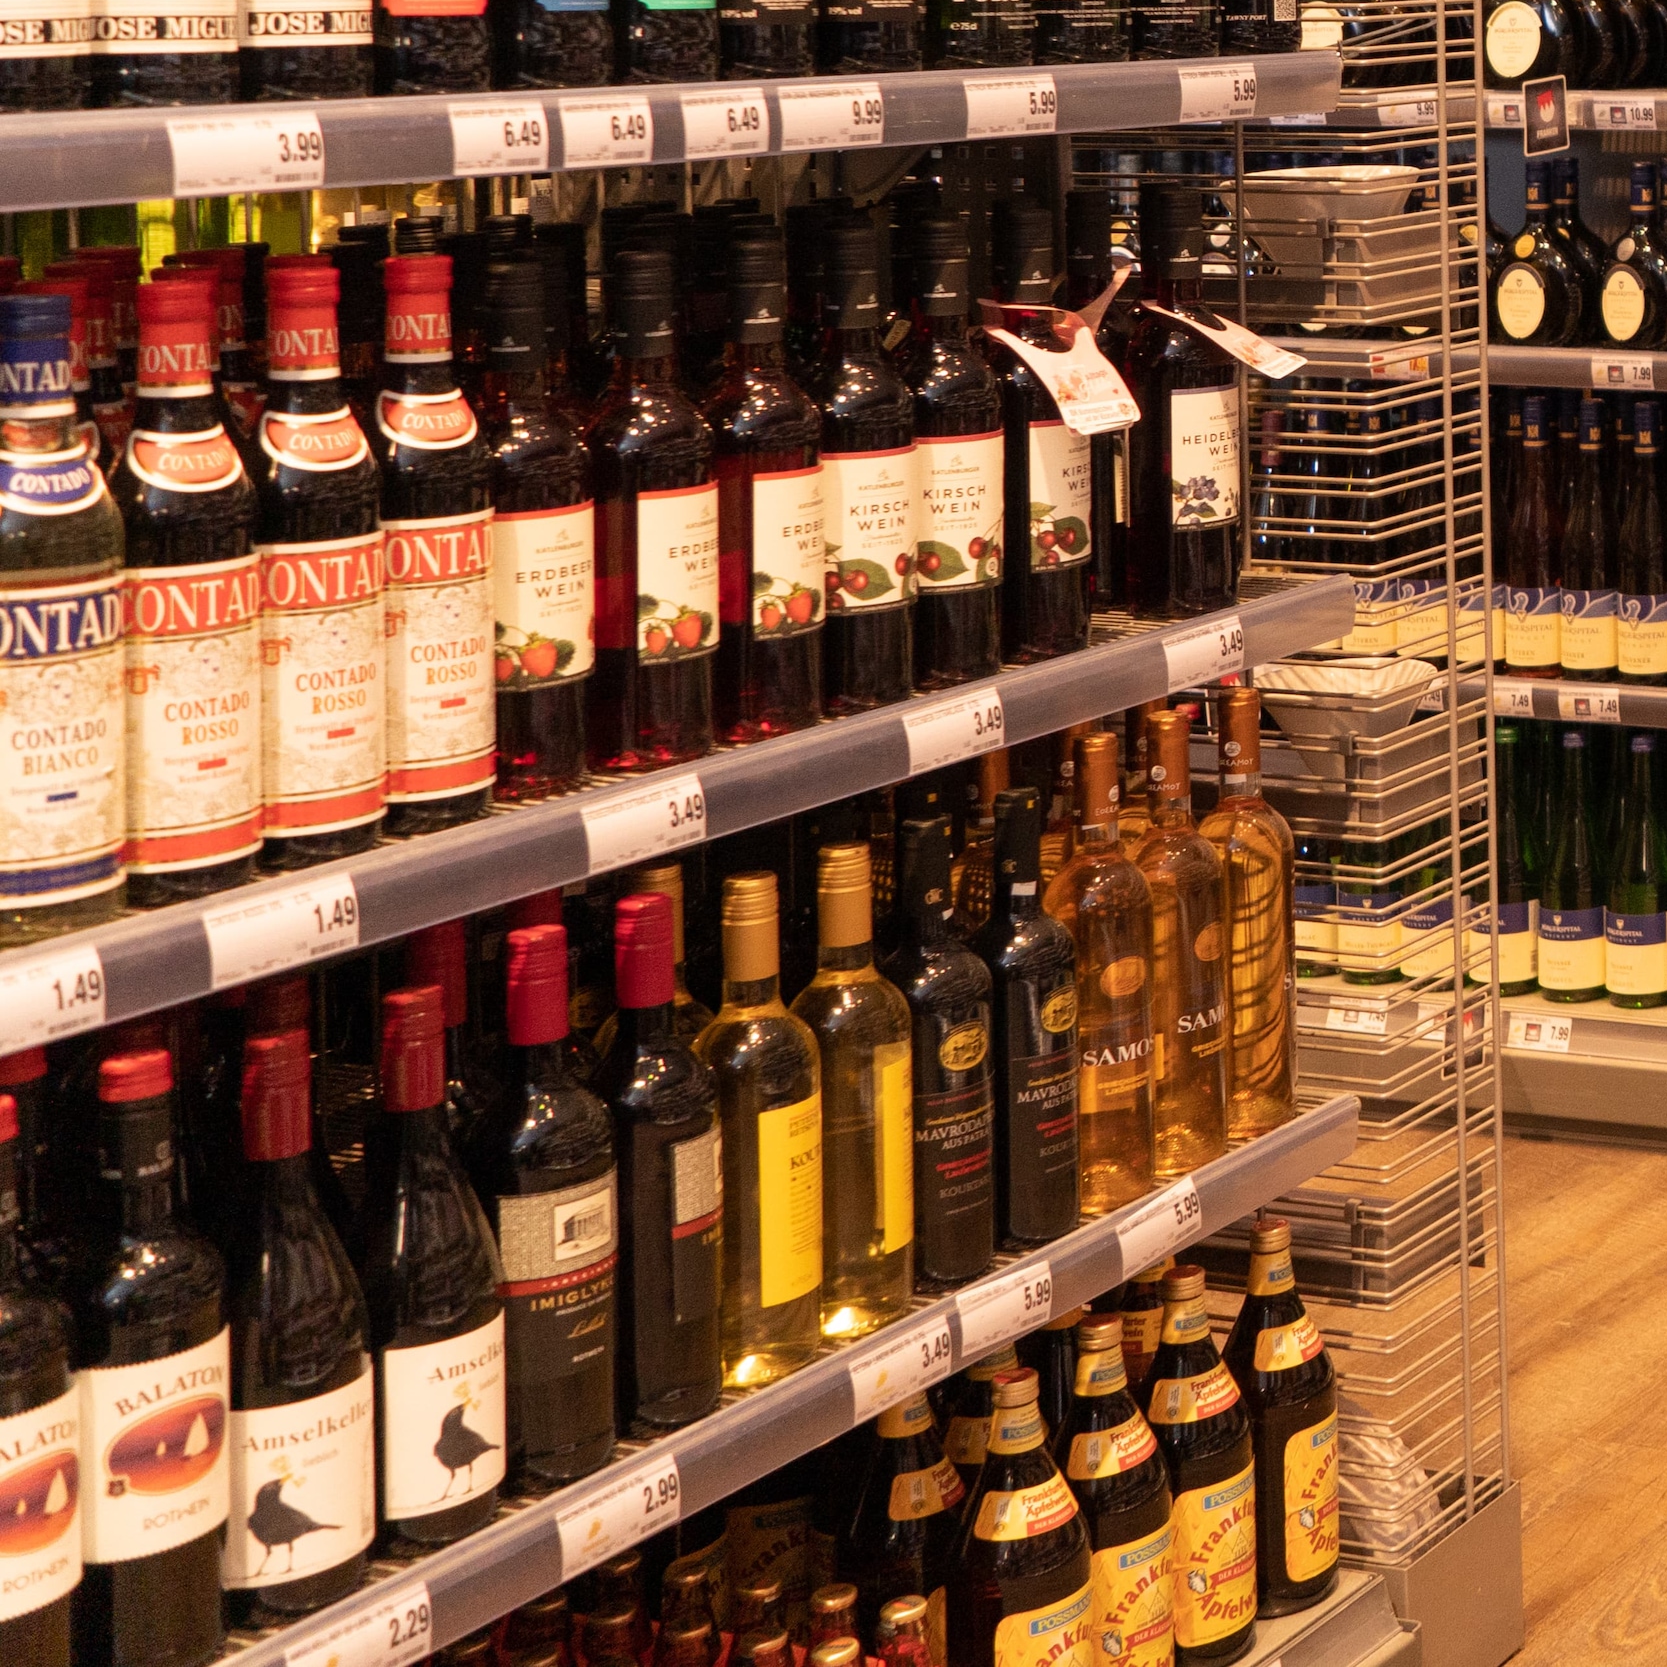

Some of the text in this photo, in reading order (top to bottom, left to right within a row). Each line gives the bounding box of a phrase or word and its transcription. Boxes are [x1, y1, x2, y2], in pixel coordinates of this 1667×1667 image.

[250, 12, 324, 35] JOSE
[1029, 88, 1056, 117] 5.99
[1233, 77, 1256, 102] 5.99
[728, 104, 760, 132] 6.49
[852, 97, 883, 125] 9.99
[1630, 107, 1653, 122] 10.99
[503, 119, 542, 147] 6.49
[610, 113, 646, 141] 6.49
[279, 130, 322, 163] 3.99
[1632, 367, 1651, 381] 7.99
[402, 408, 468, 429] CONTADO
[9, 466, 91, 494] CONTADO
[922, 484, 987, 500] KIRSCH
[849, 499, 911, 516] KIRSCH
[930, 500, 981, 515] WEIN
[857, 515, 906, 532] WEIN
[515, 559, 593, 584] ERDBEER
[535, 579, 586, 599] WEIN
[410, 635, 487, 664] CONTADO
[1220, 628, 1244, 657] 3.49
[295, 662, 377, 693] CONTADO
[425, 661, 478, 685] ROSSO
[164, 691, 250, 722] CONTADO
[311, 689, 368, 715] ROSSO
[1599, 699, 1617, 714] 7.49
[182, 718, 239, 746] ROSSO
[974, 704, 1002, 736] 3.49
[11, 718, 107, 752] CONTADO
[23, 747, 99, 777] BIANCO
[669, 791, 704, 827] 3.49
[313, 895, 357, 932] 1.49
[52, 974, 102, 1012] 1.49
[1082, 1033, 1155, 1068] SAMOS
[1173, 1191, 1200, 1226] 5.99
[1025, 1278, 1052, 1311] 5.99
[922, 1331, 951, 1369] 3.49
[114, 1364, 224, 1418] BALATON
[643, 1474, 680, 1515] 2.99
[389, 1600, 431, 1647] 2.29
